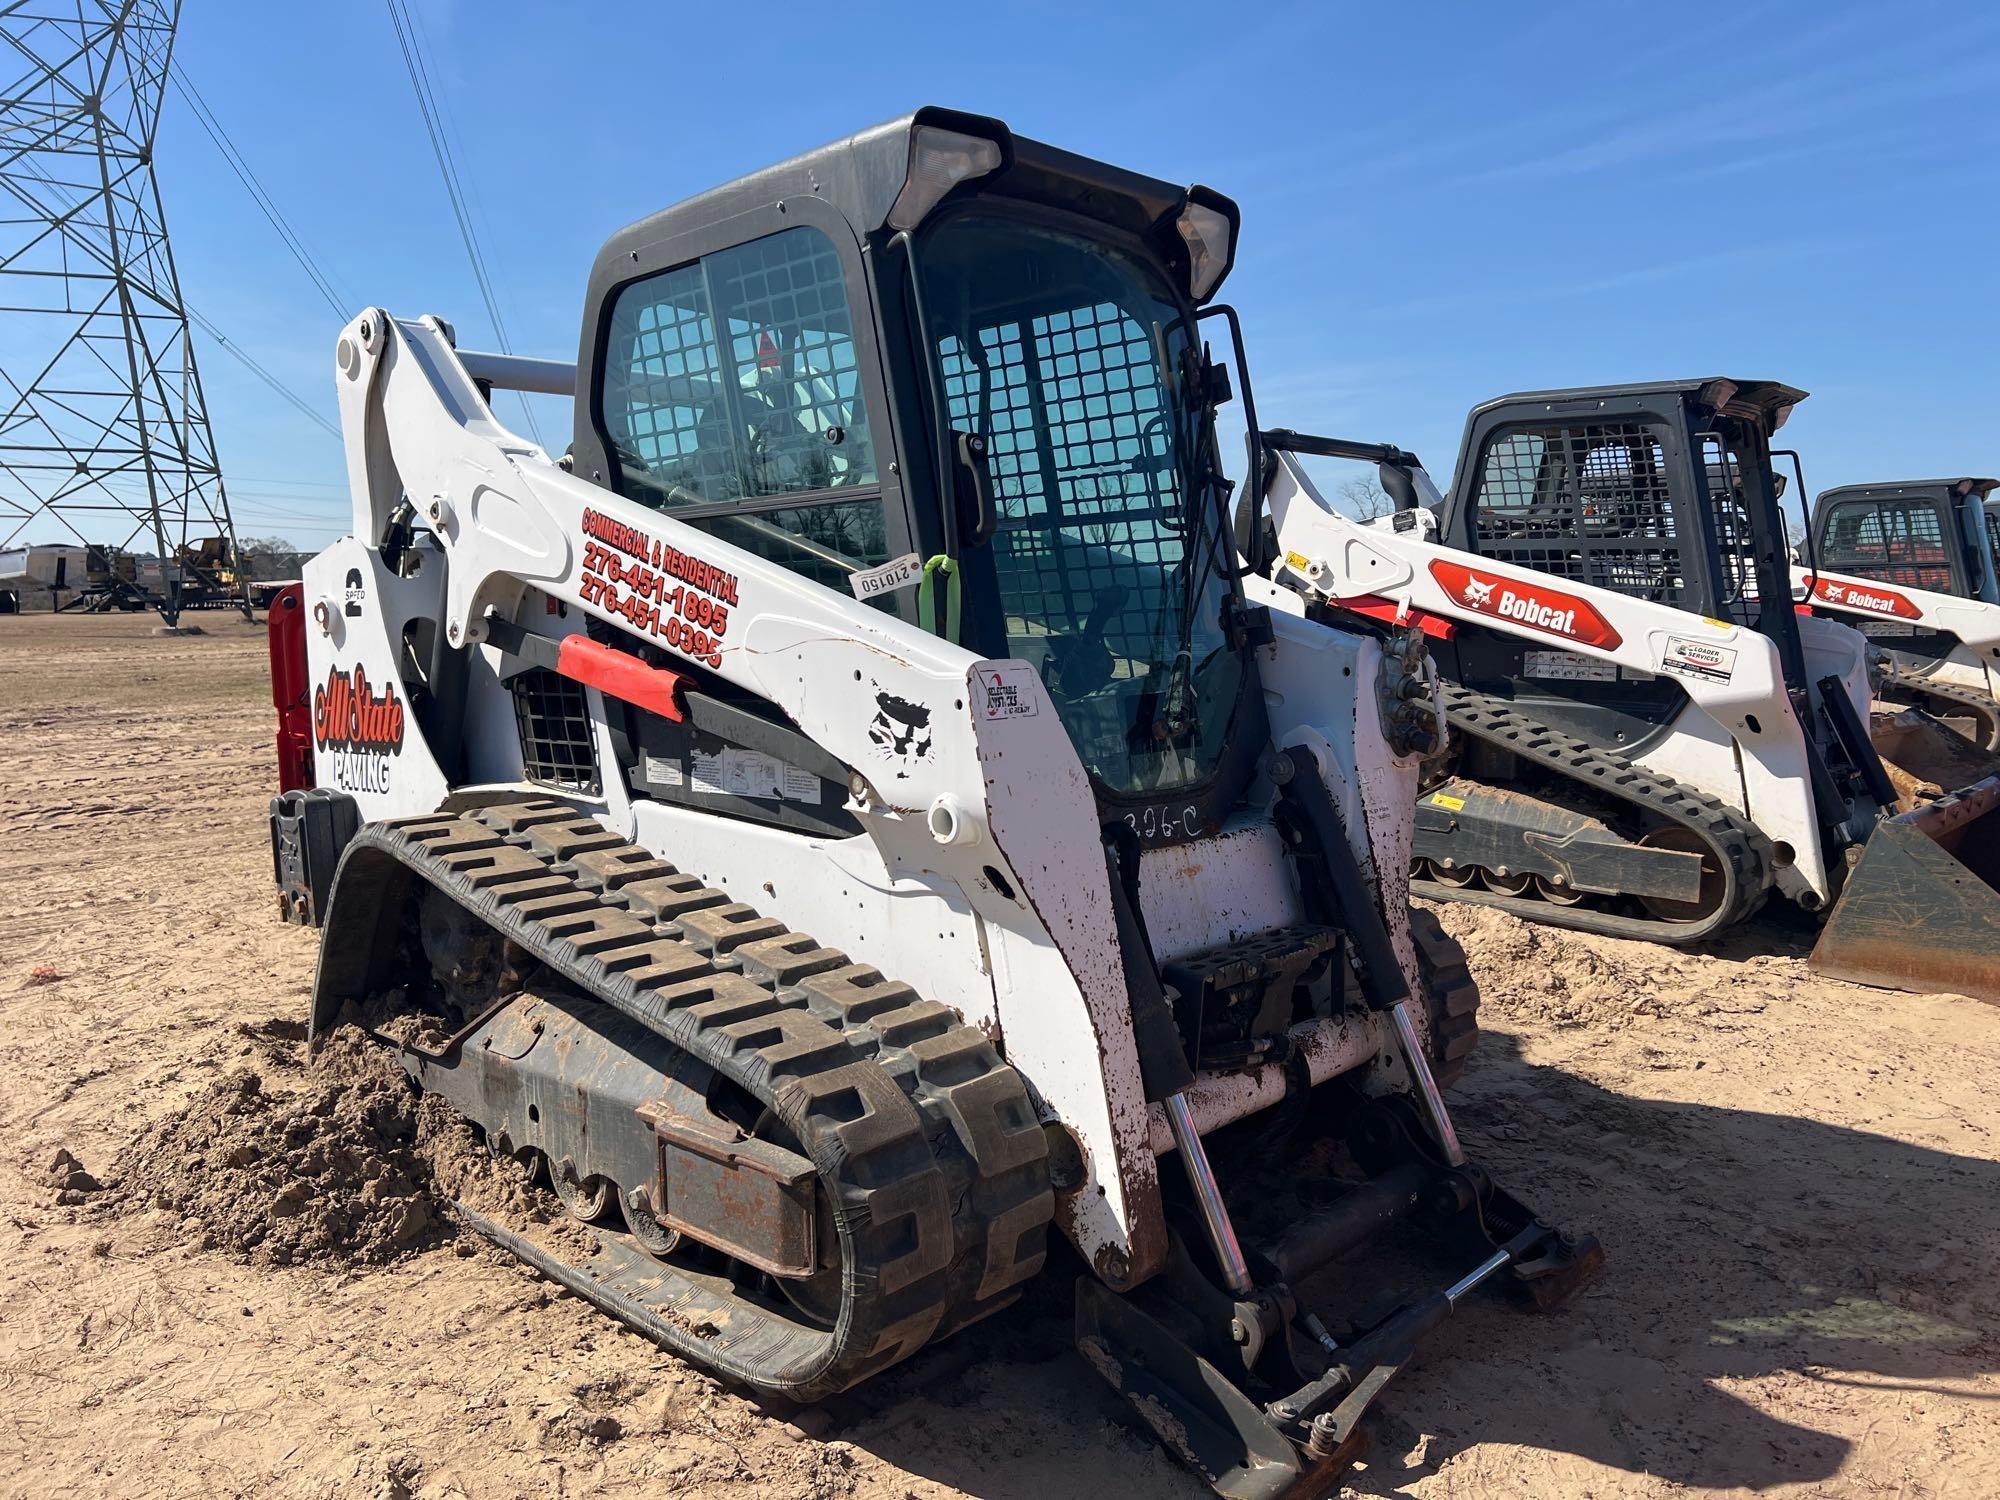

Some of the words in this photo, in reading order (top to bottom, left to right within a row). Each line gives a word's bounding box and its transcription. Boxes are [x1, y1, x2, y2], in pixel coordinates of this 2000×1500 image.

[582, 507, 650, 564] COMMERCIAL
[651, 540, 661, 568] &
[662, 544, 739, 607] RESIDENTIAL
[583, 541, 728, 637] 276-451-1895
[862, 566, 910, 592] 210150
[1498, 590, 1576, 634] Bobcat
[1847, 591, 1895, 611] Bobcat
[579, 572, 724, 669] 276-451-0395
[1688, 651, 1719, 663] SERVICES
[1694, 646, 1719, 656] LOADER
[987, 695, 1017, 709] JOYSTCKS
[334, 752, 390, 794] PAVING
